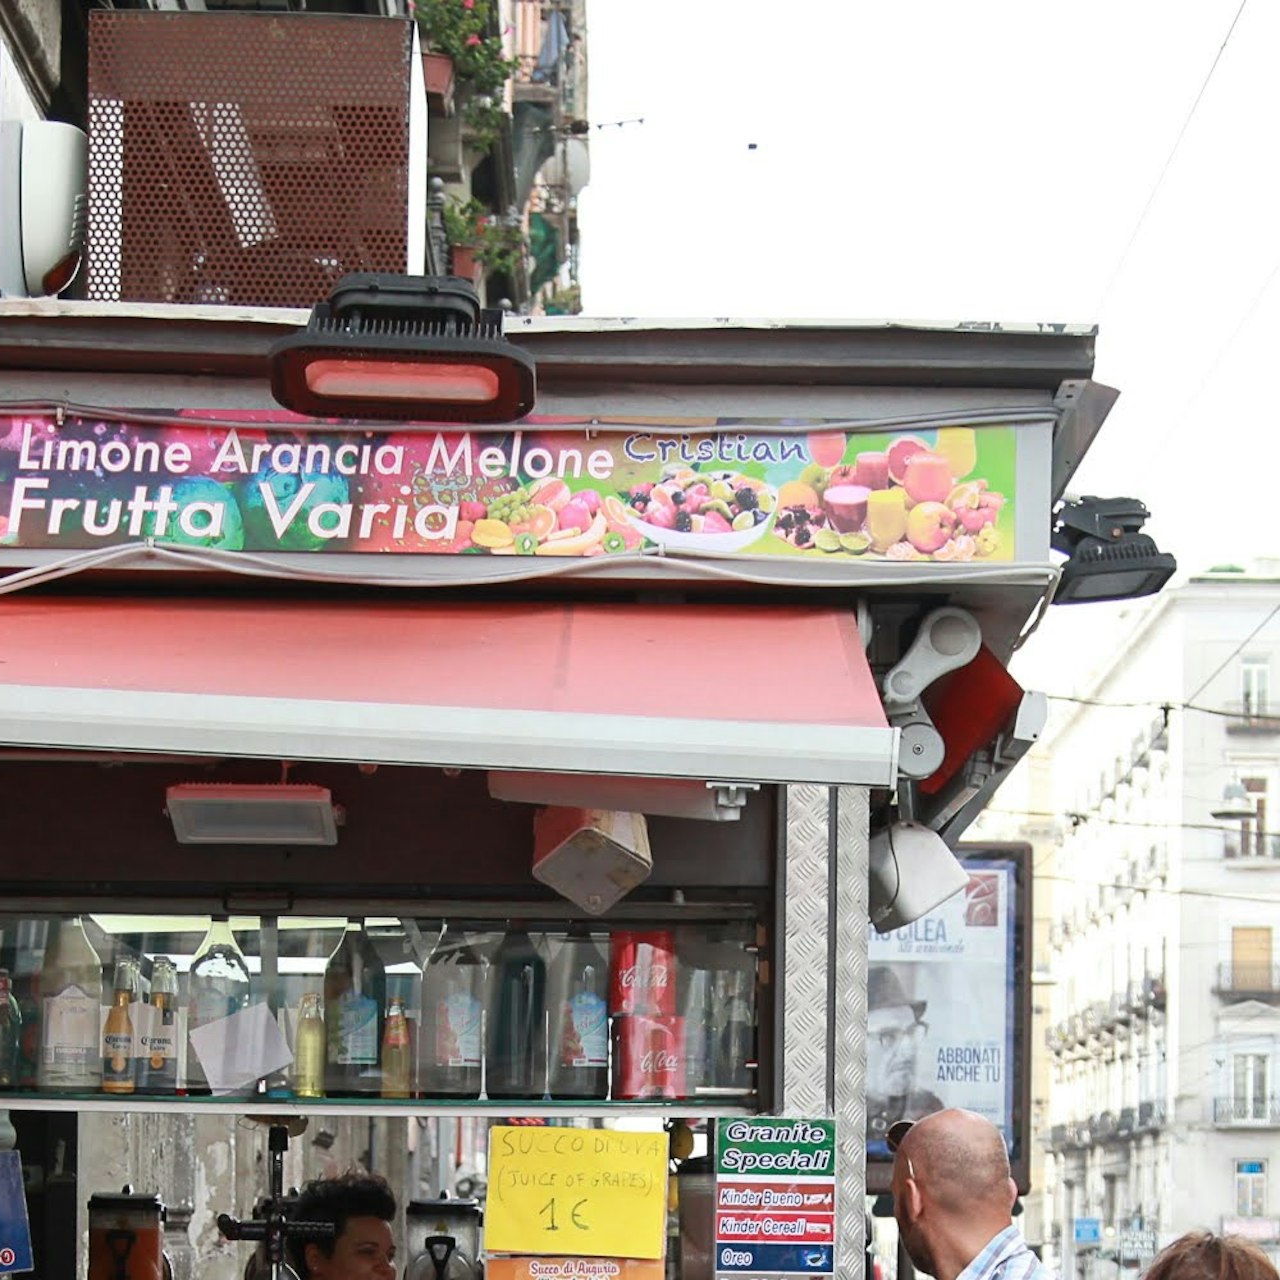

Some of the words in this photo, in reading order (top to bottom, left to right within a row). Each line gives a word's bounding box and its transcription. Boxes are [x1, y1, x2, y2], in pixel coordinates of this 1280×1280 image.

[19, 422, 193, 474] Limone
[210, 427, 405, 476] Arancia
[423, 431, 615, 479] Melone
[623, 432, 811, 464] Cristian
[6, 476, 229, 538] Frutta
[259, 481, 461, 542] Varia
[937, 1047, 1000, 1065] ABBONATI
[937, 1064, 981, 1082] ANCHE
[985, 1064, 1000, 1083] TU
[726, 1122, 827, 1144] Granite
[501, 1129, 584, 1159] SUCCO
[721, 1149, 832, 1172] Speciali
[564, 1172, 588, 1189] OF
[720, 1189, 759, 1206] Kinder
[762, 1191, 802, 1207] Bueno
[719, 1219, 759, 1235] Kinder
[762, 1219, 805, 1236] Cereali
[721, 1249, 752, 1267] Oreo
[529, 1263, 559, 1276] Succo
[561, 1263, 573, 1276] di
[577, 1263, 620, 1278] Anguria
